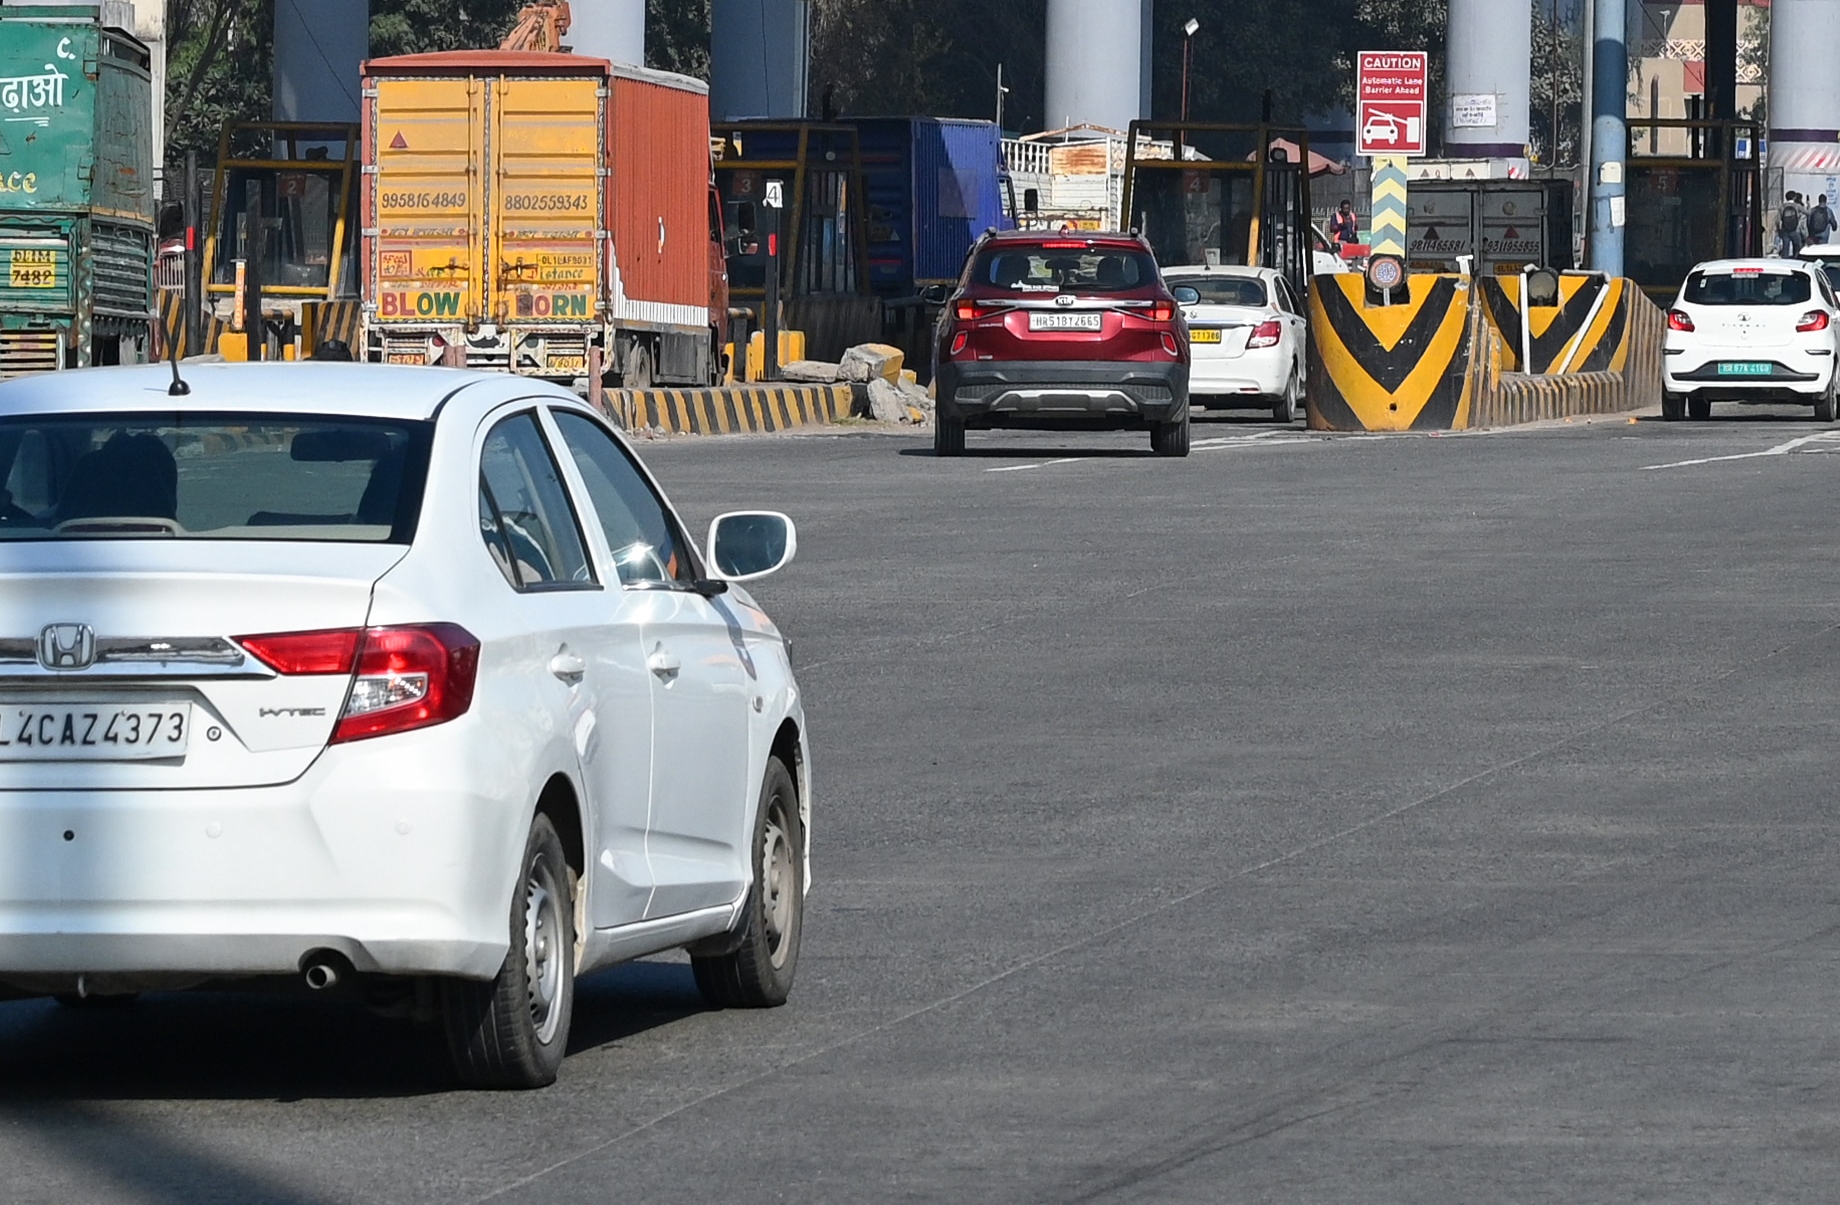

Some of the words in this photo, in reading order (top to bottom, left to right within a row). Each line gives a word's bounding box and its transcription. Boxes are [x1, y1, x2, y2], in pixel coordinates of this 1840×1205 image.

[1364, 57, 1421, 68] CAUTION
[0, 63, 70, 113] ढ़ाओ
[1362, 77, 1402, 85] Automatic
[1405, 77, 1423, 85] Lane
[1365, 86, 1393, 94] Barrier
[1395, 86, 1420, 94] Ahead
[287, 180, 297, 195] 2
[741, 179, 751, 193] 3
[767, 185, 780, 203] 4
[381, 192, 466, 209] 9958164849
[504, 194, 588, 211] 8802559343
[382, 292, 460, 316] BLOW
[515, 294, 587, 316] HORN
[0, 711, 184, 746] L4CAZ4373
